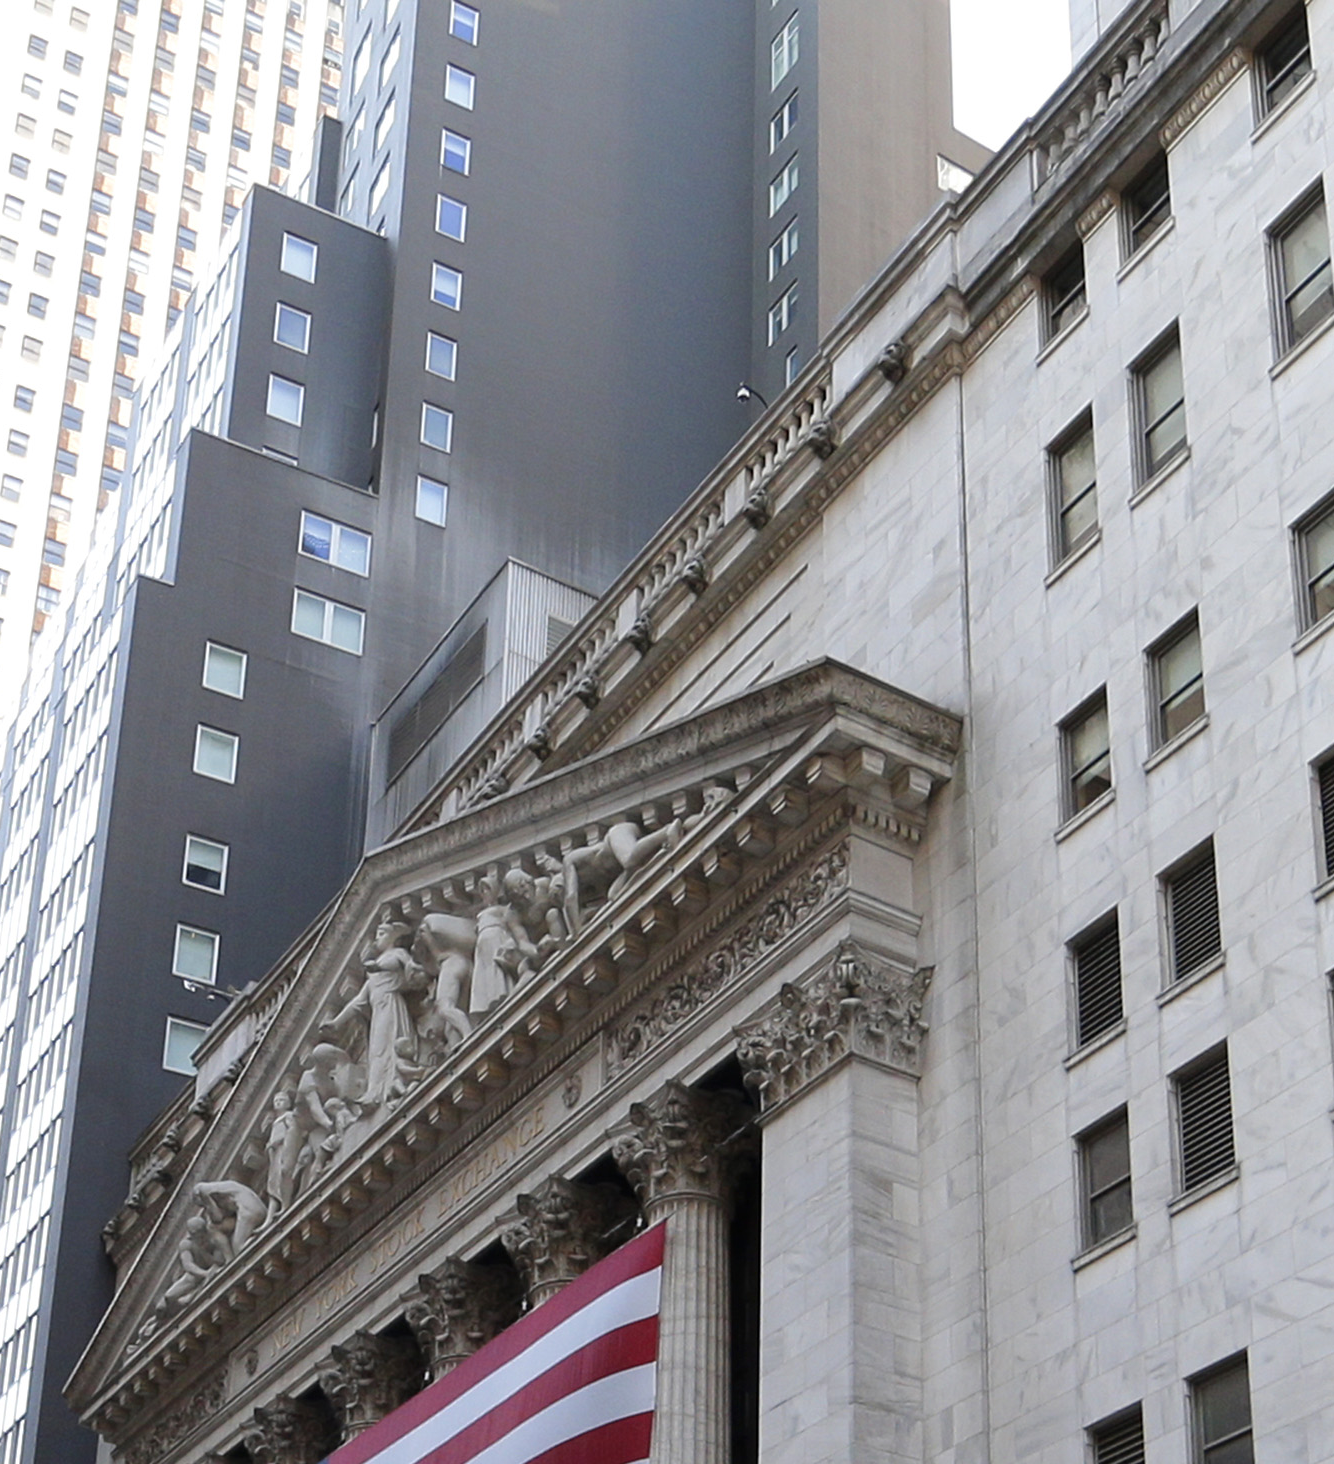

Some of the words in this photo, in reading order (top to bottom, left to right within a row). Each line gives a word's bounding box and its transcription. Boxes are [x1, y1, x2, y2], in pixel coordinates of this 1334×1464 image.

[270, 1306, 306, 1358] NEW
[316, 1263, 359, 1319] YORK
[369, 1205, 425, 1275] STOCK
[437, 1104, 546, 1219] EXCHANGE
